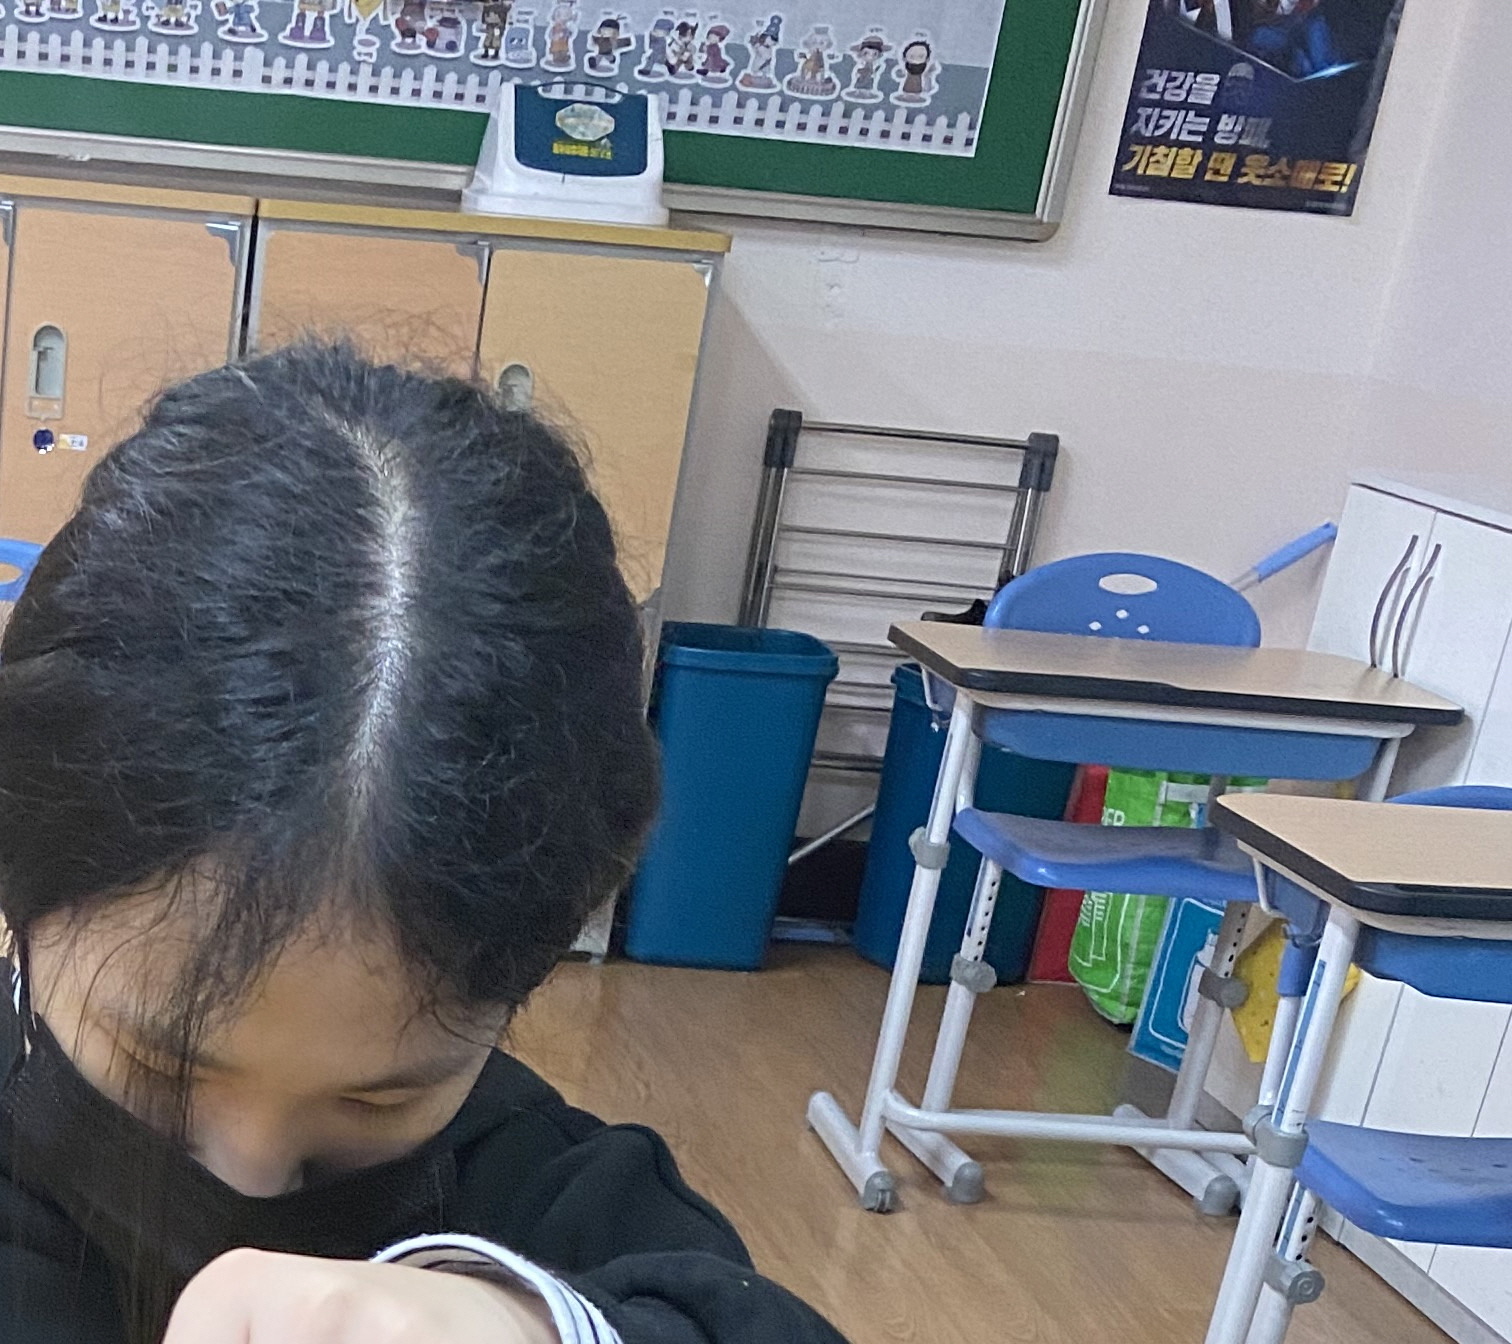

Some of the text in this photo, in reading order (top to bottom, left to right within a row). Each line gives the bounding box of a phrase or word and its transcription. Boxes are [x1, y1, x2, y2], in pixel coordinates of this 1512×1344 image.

[1138, 68, 1221, 105] 건강을
[1130, 106, 1211, 142] 지키는
[1122, 144, 1204, 180] 기침할
